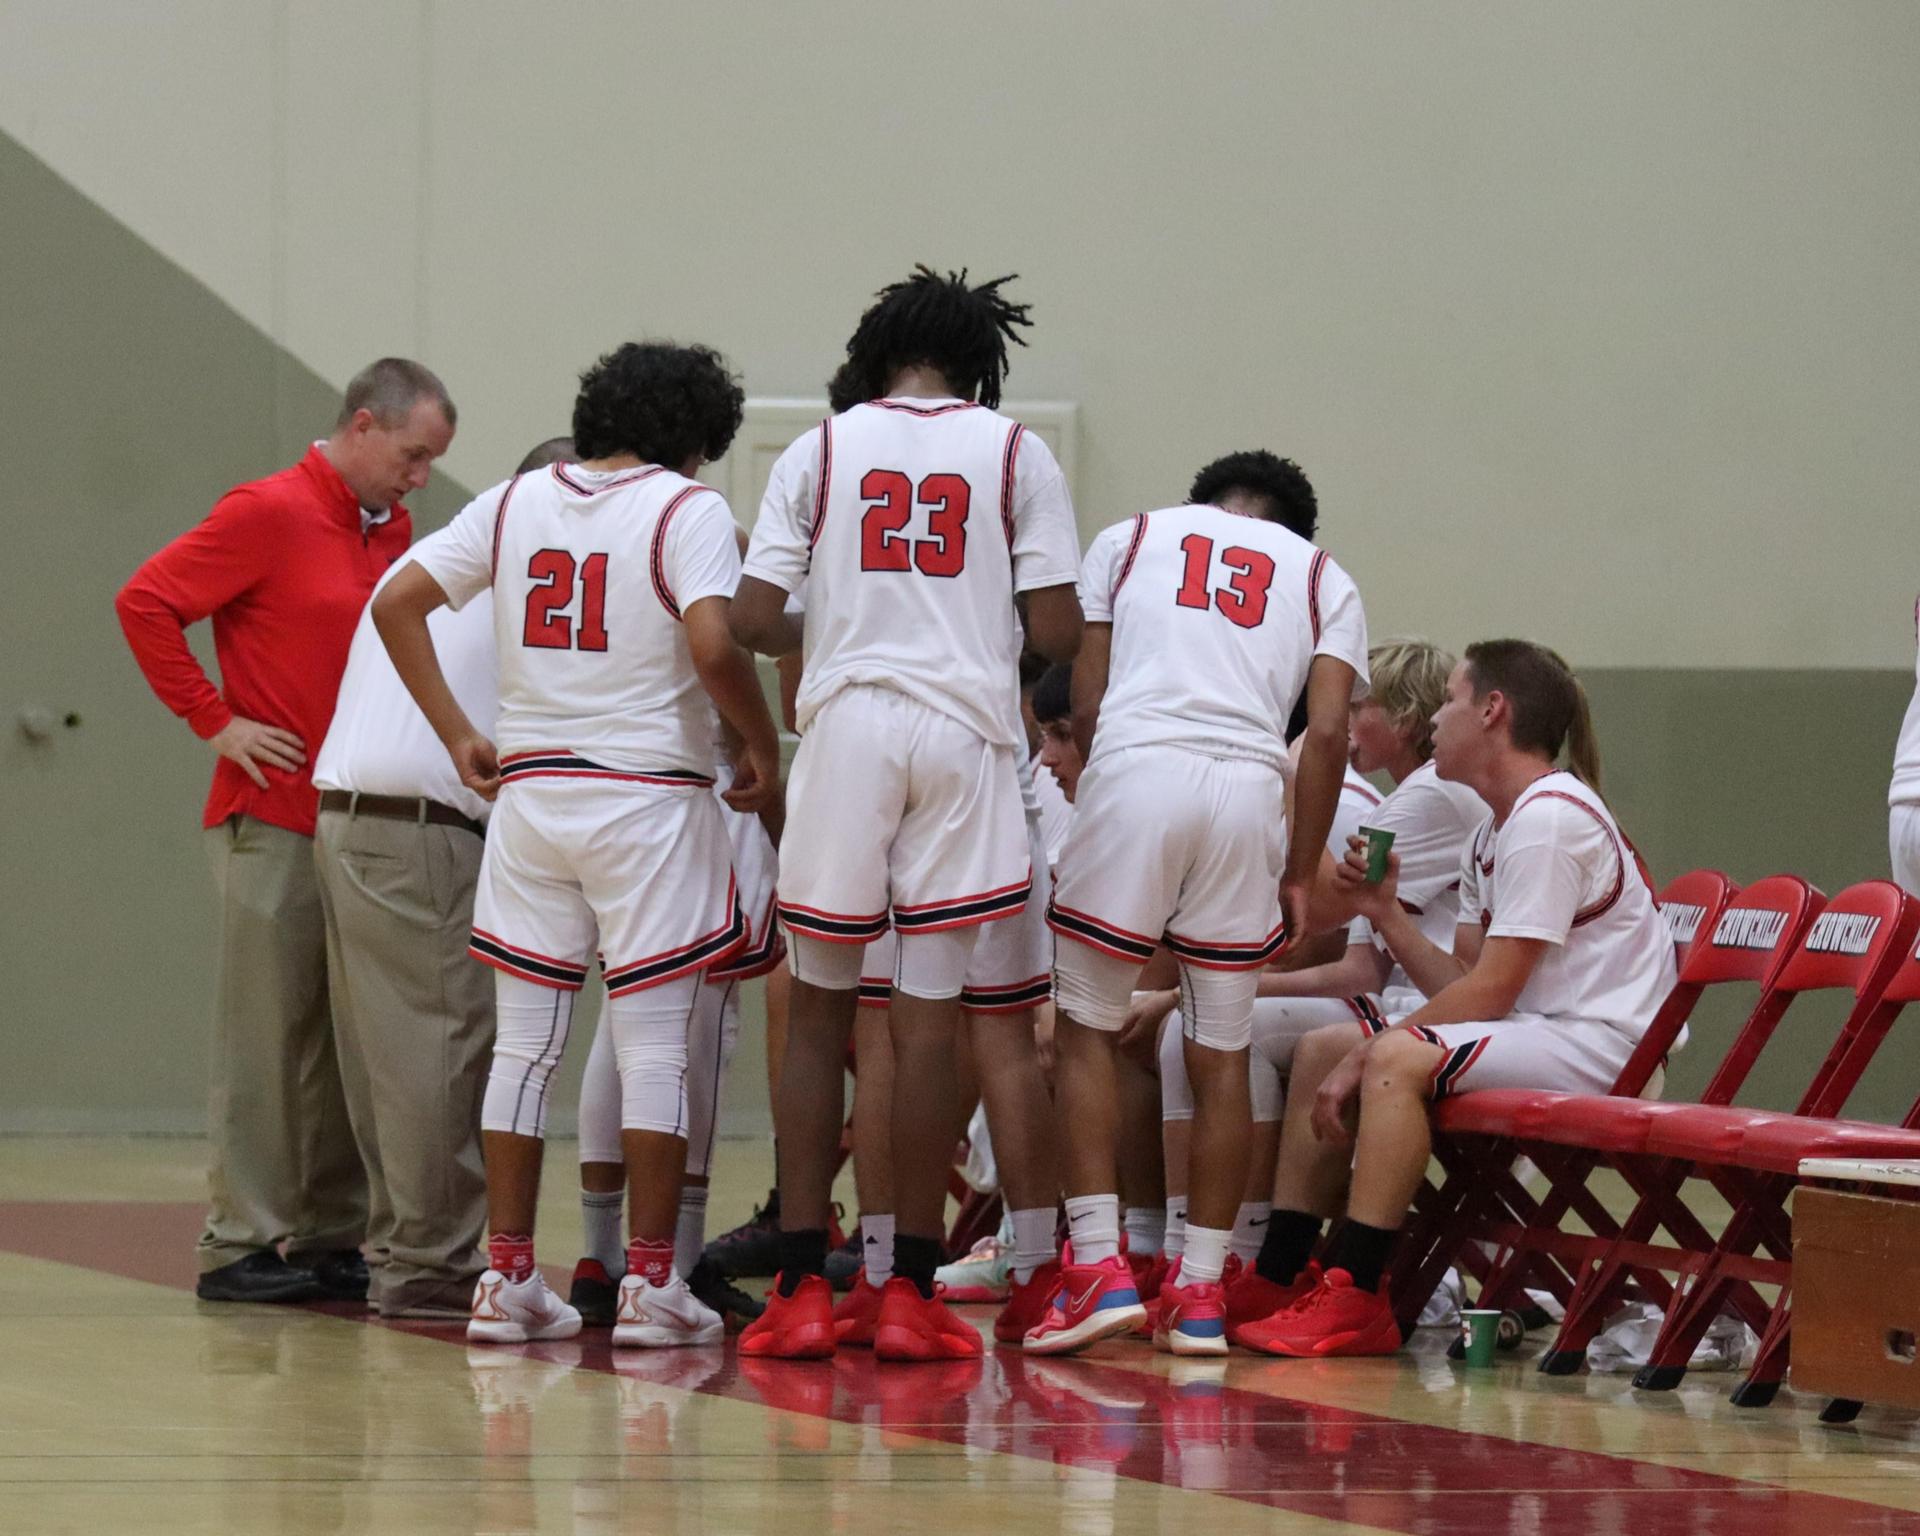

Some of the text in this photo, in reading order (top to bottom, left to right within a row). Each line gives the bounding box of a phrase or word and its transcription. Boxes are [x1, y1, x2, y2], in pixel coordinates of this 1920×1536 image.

[860, 468, 971, 578] 23
[522, 548, 609, 653] 21
[1176, 533, 1276, 629] 13
